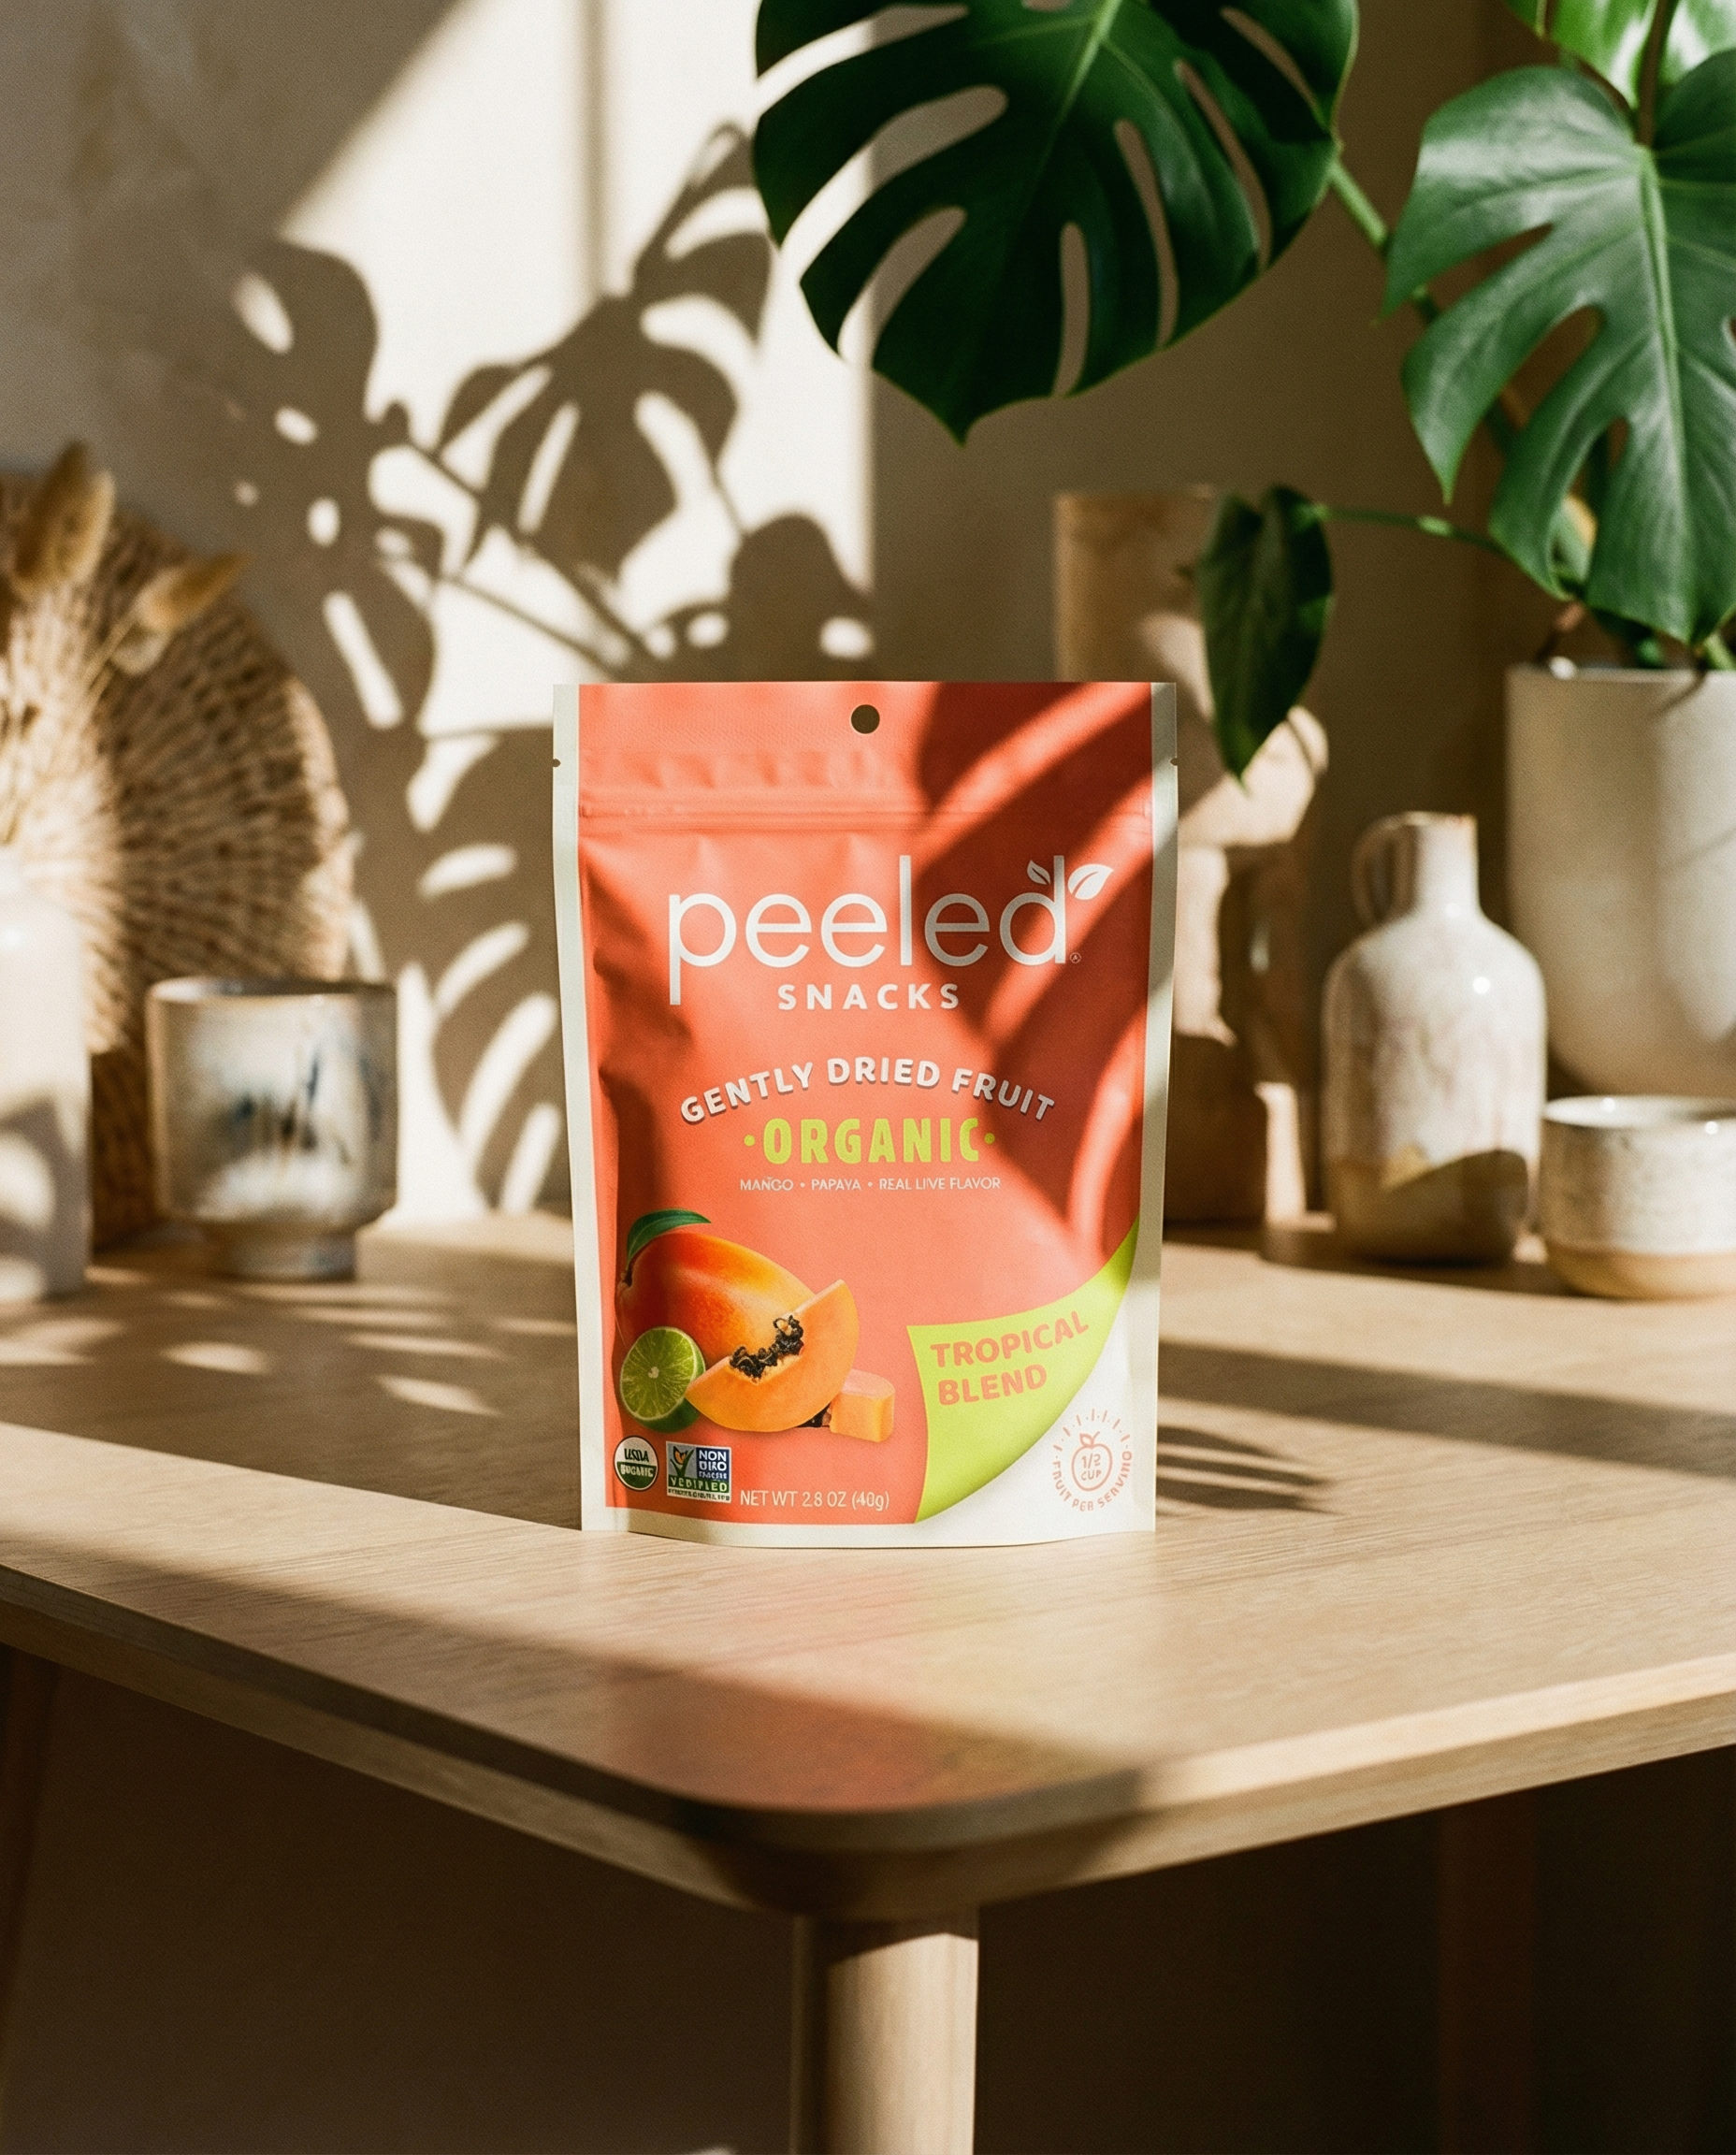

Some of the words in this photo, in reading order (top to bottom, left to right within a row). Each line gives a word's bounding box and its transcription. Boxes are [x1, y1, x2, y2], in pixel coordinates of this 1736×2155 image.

[669, 855, 1066, 1005] peeled
[777, 983, 959, 1010] SNACKS
[680, 1061, 814, 1124] GENTLY
[827, 1056, 941, 1089] DRIED
[950, 1067, 1056, 1121] FRUIT
[762, 1118, 979, 1164] ORGANIC
[740, 1178, 794, 1191] MANGO
[811, 1179, 861, 1191] PAPAYA
[879, 1178, 913, 1191] REAL
[949, 1177, 1001, 1190] FLAVOR
[930, 1310, 1090, 1368] TROPICAL
[938, 1364, 1048, 1406] BLEND
[699, 1450, 727, 1462] NON
[1080, 1469, 1102, 1481] CUP
[740, 1490, 769, 1506] NET
[772, 1490, 798, 1507] WT
[827, 1491, 847, 1507] OZ
[851, 1491, 890, 1511] (40g)
